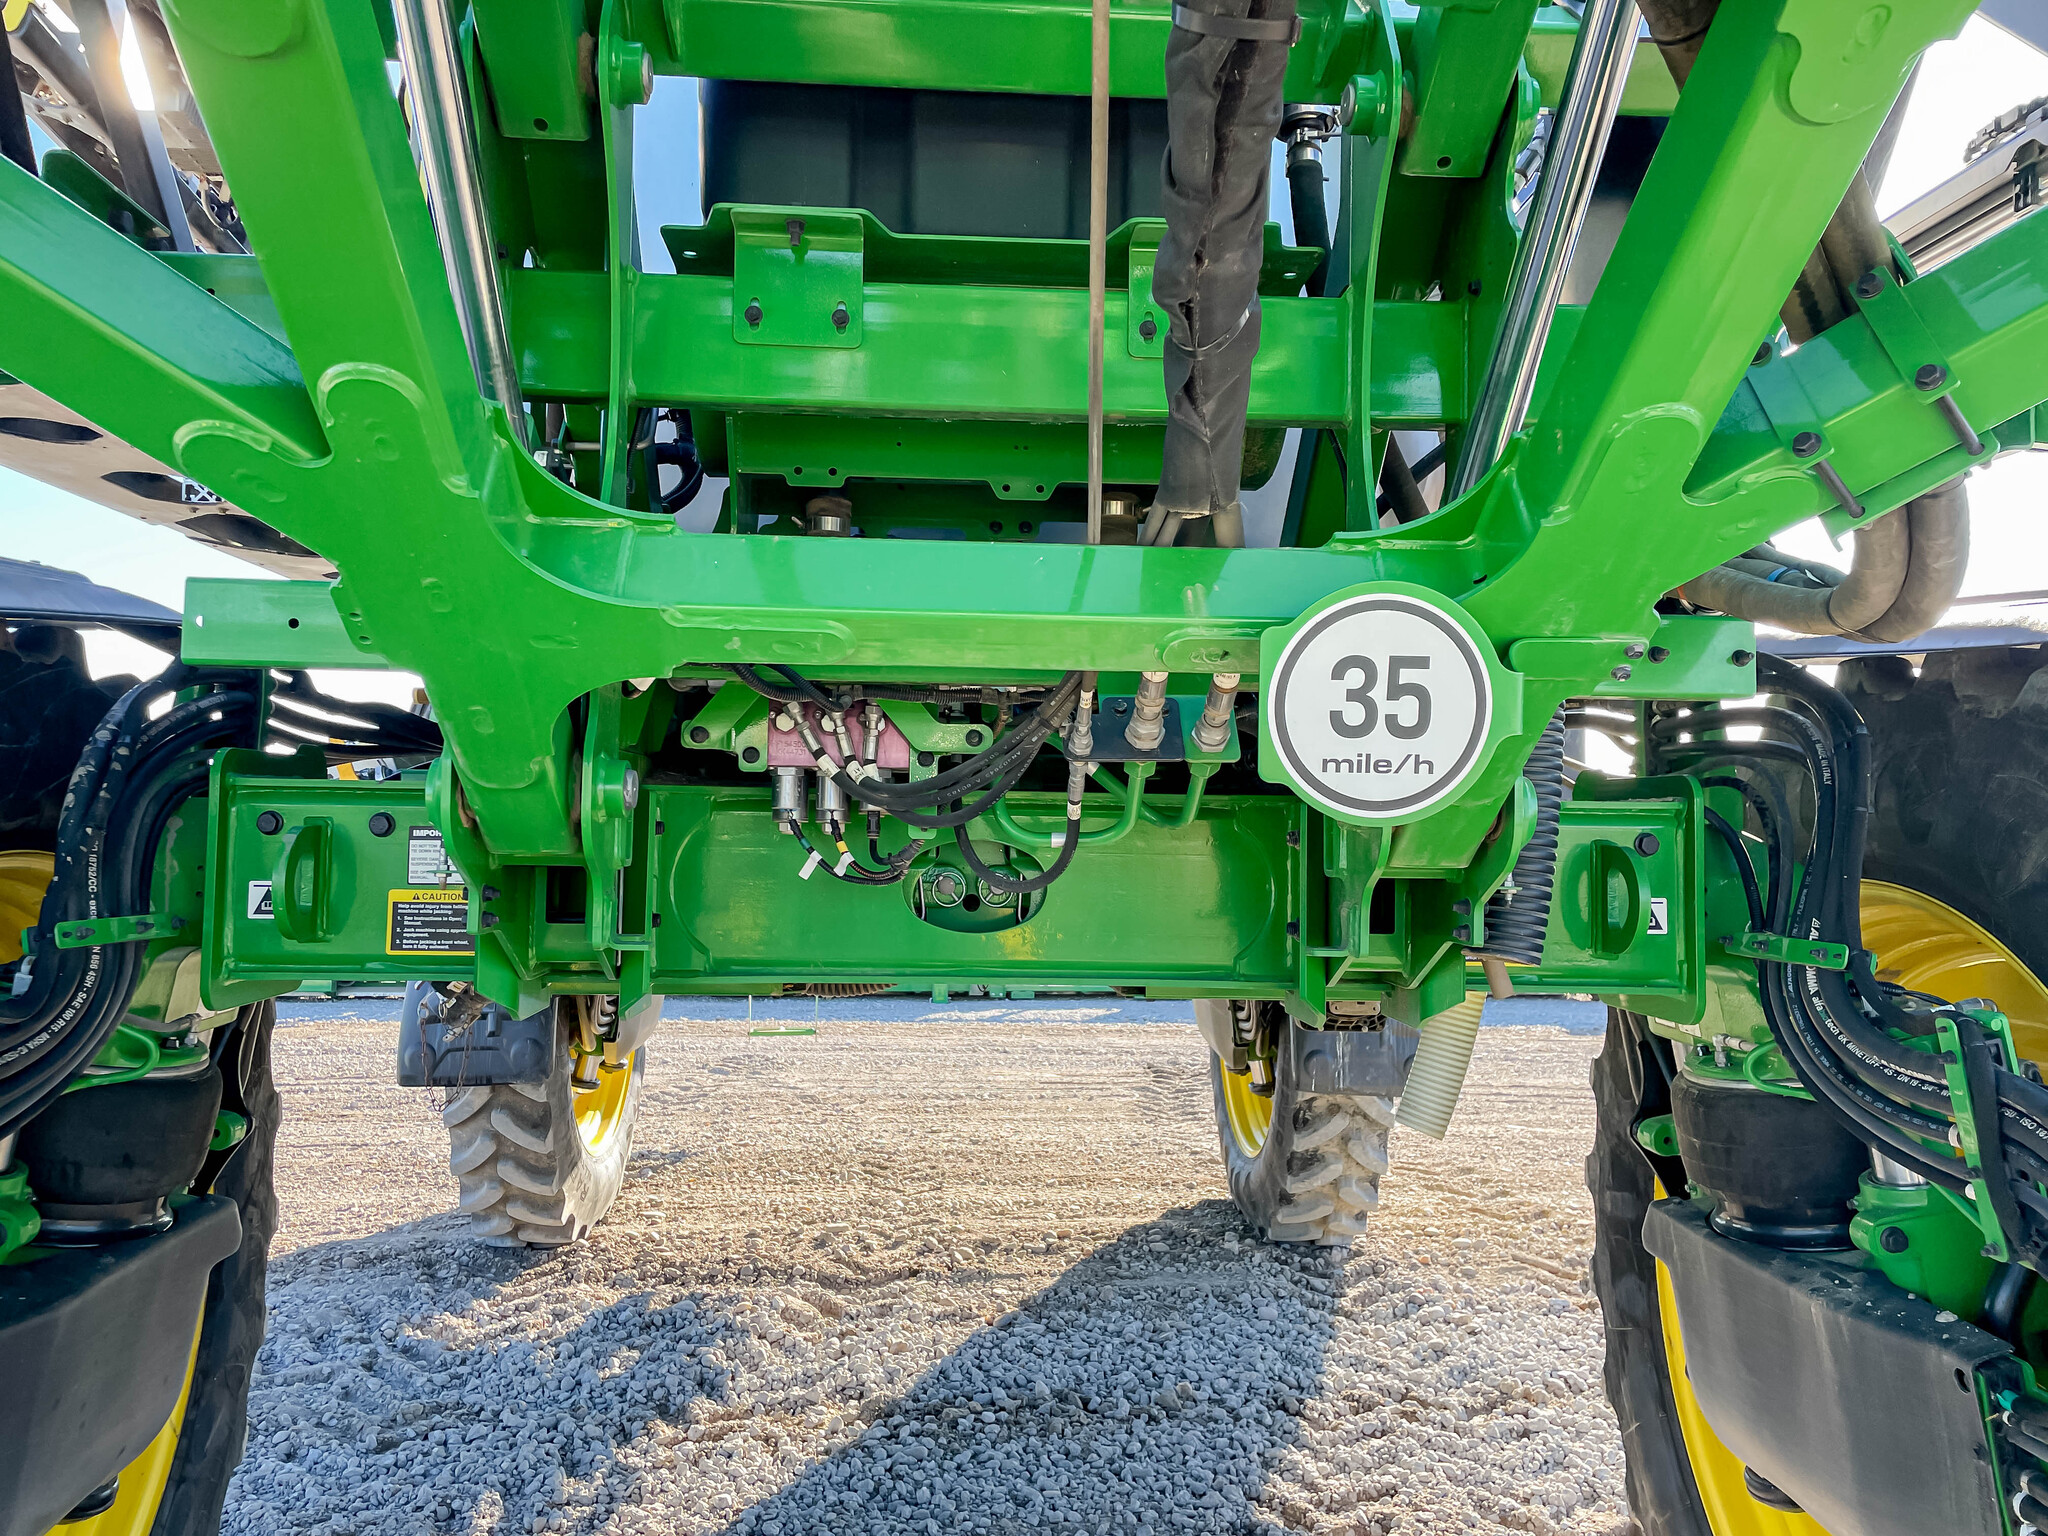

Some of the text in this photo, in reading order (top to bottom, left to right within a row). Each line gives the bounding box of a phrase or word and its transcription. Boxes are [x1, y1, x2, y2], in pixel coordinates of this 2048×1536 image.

[1329, 654, 1432, 740] 35
[1322, 753, 1434, 775] mile/h
[1822, 766, 1832, 785] ITALY
[83, 971, 97, 988] 4SH
[71, 991, 88, 1009] SAE
[62, 1009, 76, 1020] 100
[51, 1018, 67, 1032] R15
[1837, 1034, 1849, 1045] 6K
[1845, 1042, 1880, 1068] MINETUFF
[1897, 1074, 1911, 1083] DN
[2019, 1116, 2037, 1130] ISO
